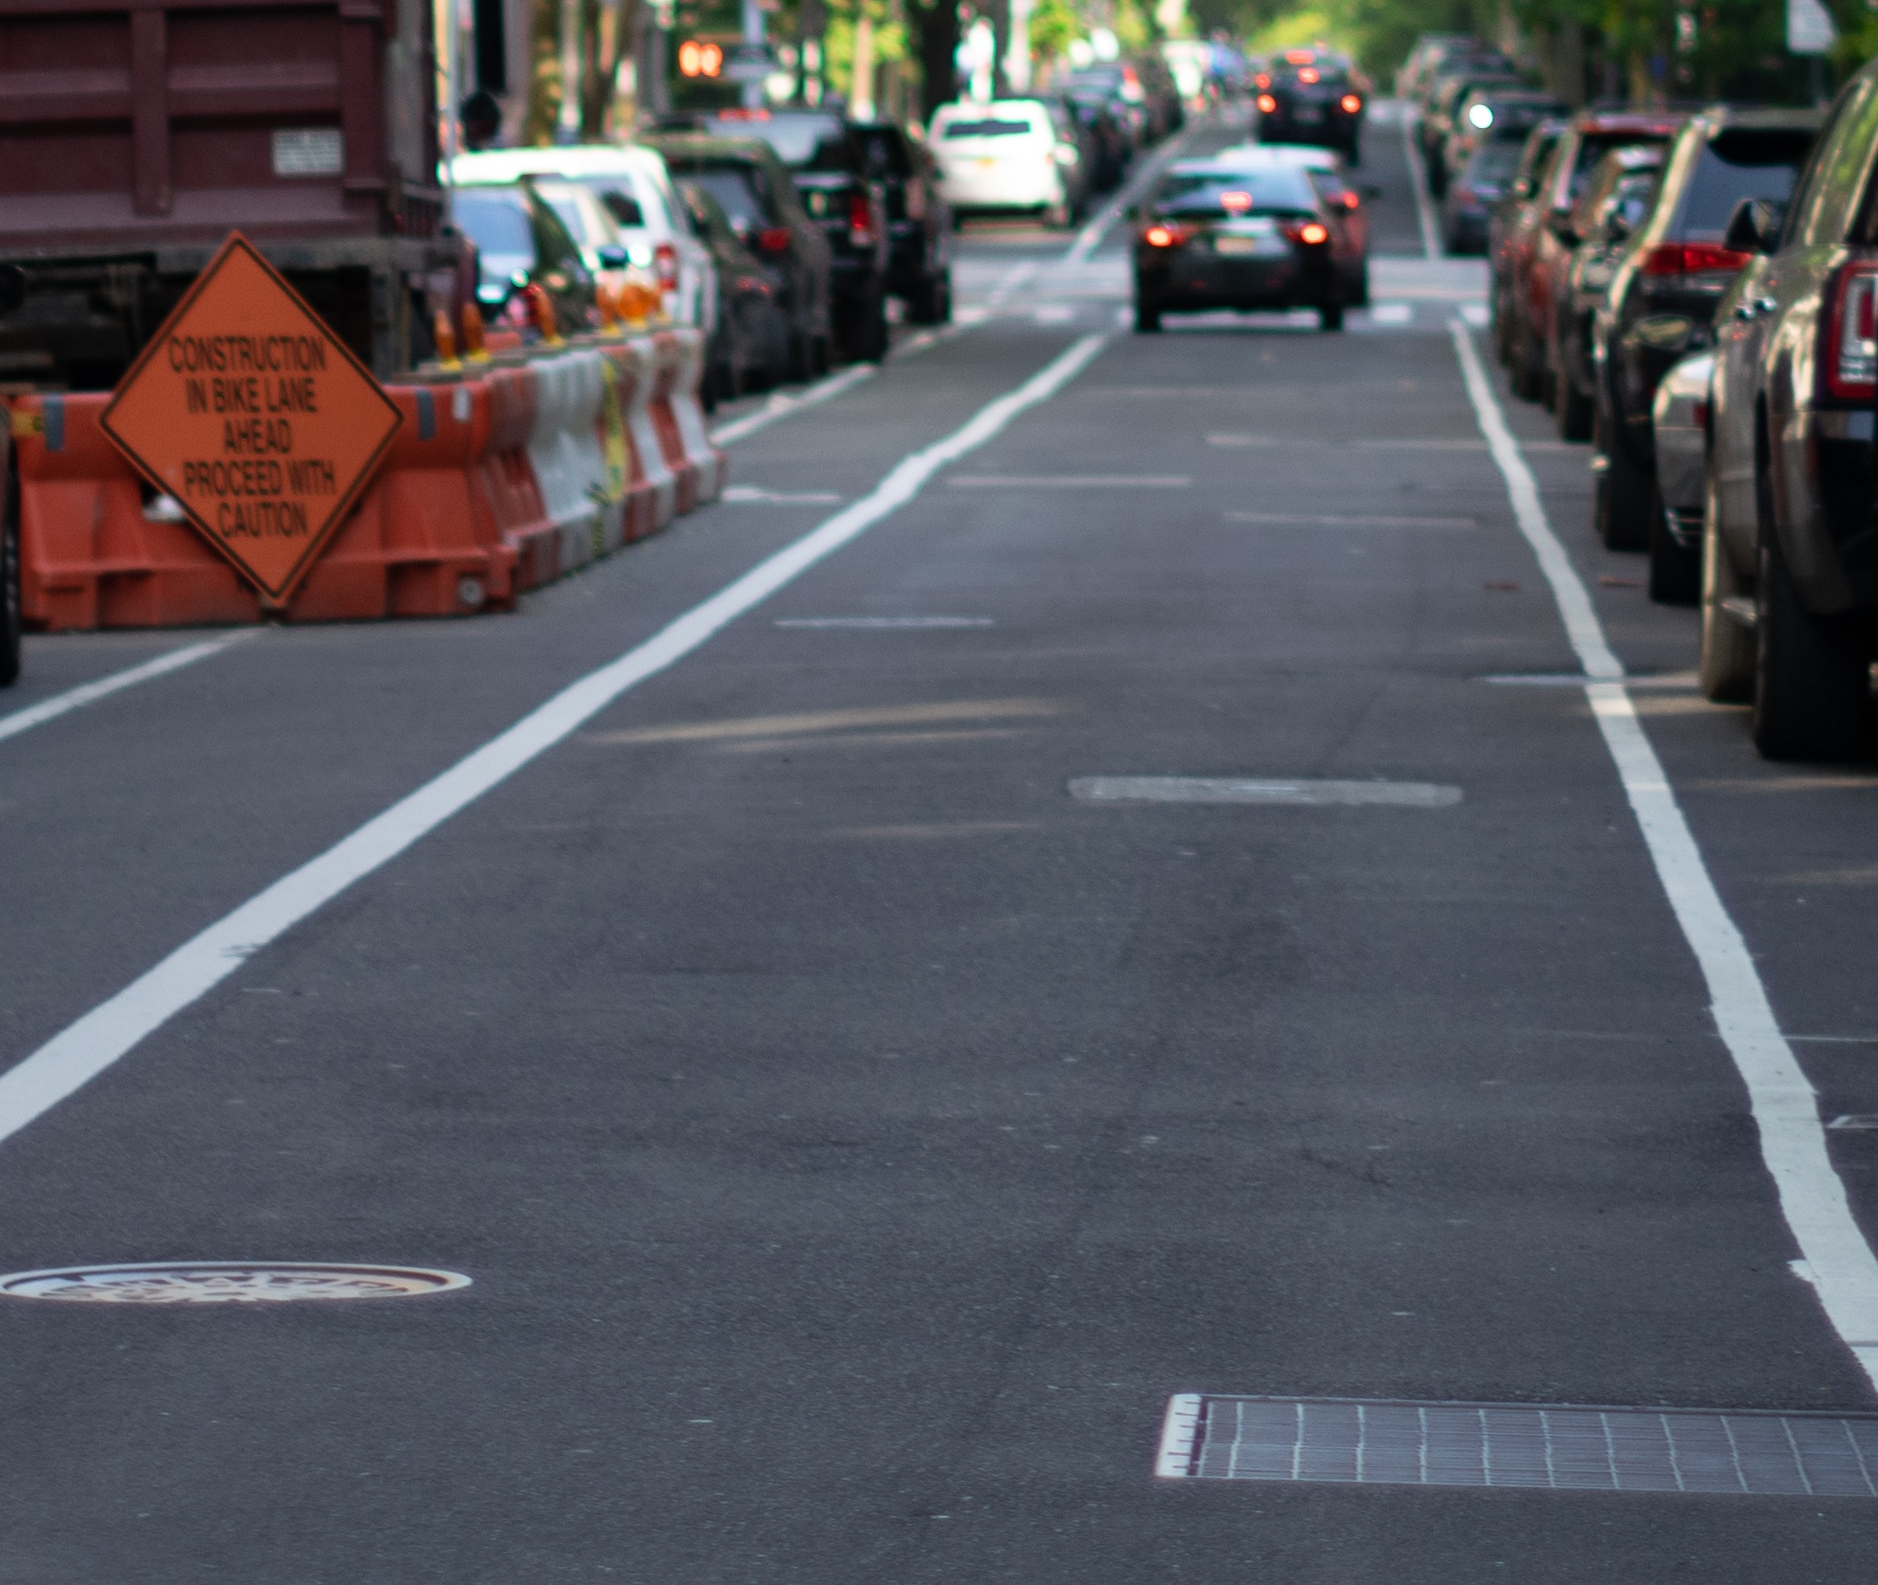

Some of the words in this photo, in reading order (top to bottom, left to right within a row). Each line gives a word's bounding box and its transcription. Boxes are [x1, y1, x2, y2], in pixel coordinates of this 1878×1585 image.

[168, 336, 327, 372] CONSTRUCTION
[185, 377, 208, 413] IN
[214, 377, 261, 413] BIKE
[264, 377, 319, 414] LANE
[224, 419, 294, 455] AHEAD
[183, 461, 282, 497] PROCEED
[288, 461, 336, 496] WITH
[220, 501, 309, 537] CAUTION
